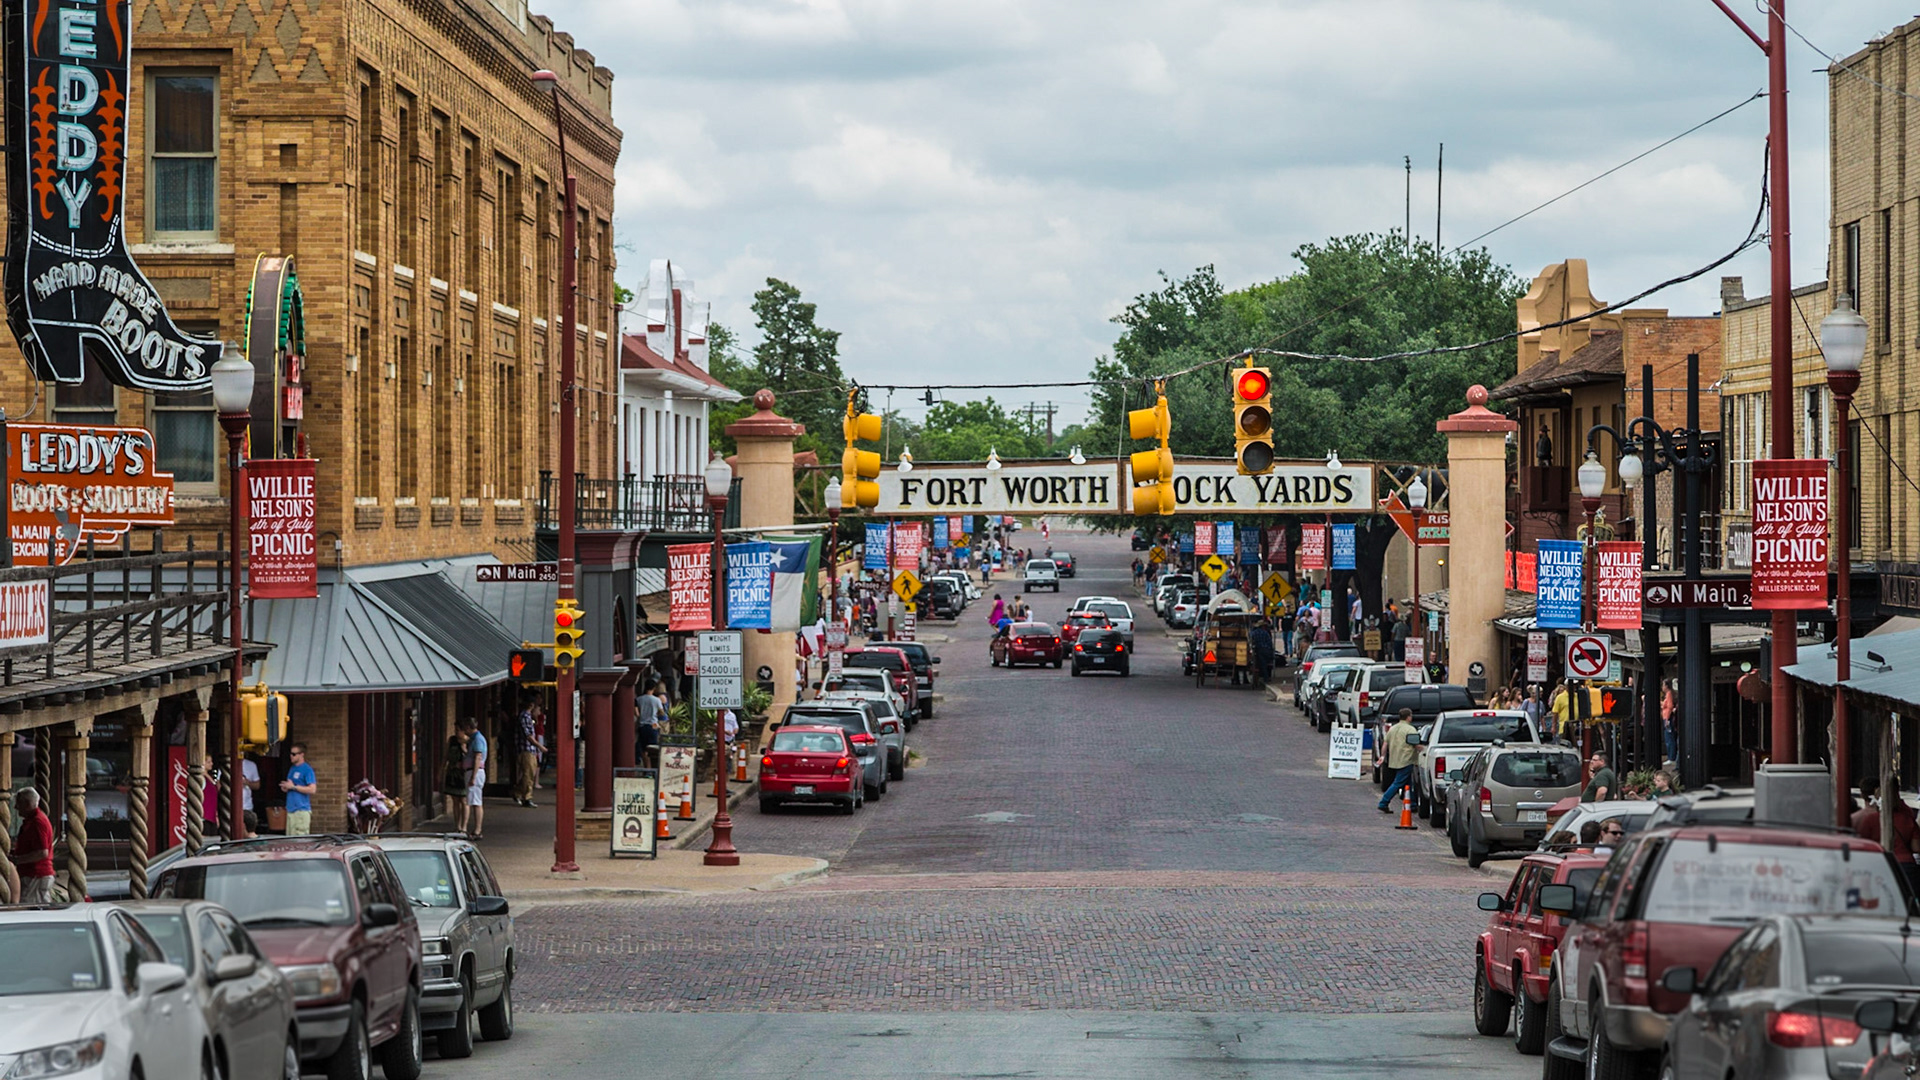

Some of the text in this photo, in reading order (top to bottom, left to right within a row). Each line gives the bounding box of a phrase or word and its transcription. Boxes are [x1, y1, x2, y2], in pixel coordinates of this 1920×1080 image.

[56, 0, 99, 229] EDDY
[33, 261, 161, 325] HAND MADE
[100, 298, 206, 380] BOOTS
[20, 431, 147, 476] LEDDY'S
[249, 476, 314, 498] WILLIE
[899, 476, 1109, 507] FORT WORTH
[1251, 474, 1353, 505] YARDS
[1754, 477, 1827, 501] WILLIE
[11, 482, 69, 514] BOOTS
[83, 484, 169, 515] SADDLERY
[251, 499, 314, 518] NELSON'S
[1756, 501, 1826, 522] NELSON'S
[55, 525, 65, 540] &
[250, 518, 314, 533] 4th of July
[1754, 522, 1826, 538] 4th of July
[12, 541, 65, 557] EXCHANE
[251, 533, 314, 556] PICNIC
[1754, 538, 1826, 563] PICNIC
[669, 553, 710, 569] WILLIE
[728, 552, 770, 567] WILLIE
[1539, 550, 1582, 565] WILLIE
[1599, 552, 1642, 566] WILLIE
[254, 575, 310, 583] WILLIESPICNIC.COM
[492, 566, 501, 579] N
[507, 566, 536, 579] Main
[539, 573, 557, 581] 2450
[671, 568, 710, 581] NELSON'S
[729, 567, 770, 580] NELSON'S
[1540, 565, 1581, 578] NELSON'S
[1600, 566, 1641, 579] NELSON'S
[729, 588, 770, 602] PICNIC
[1538, 586, 1580, 601] PICNIC
[1599, 588, 1641, 603] PICNIC
[1671, 583, 1737, 603] N Main
[1758, 584, 1820, 592] WILLIESPICNIC.COM
[671, 588, 709, 605] PICNIC
[709, 656, 731, 664] GROSS
[701, 665, 728, 674] 54000
[701, 697, 729, 705] 24000
[1332, 736, 1360, 745] VALET
[622, 793, 645, 804] LUNCH
[616, 804, 650, 815] SPECIALS
